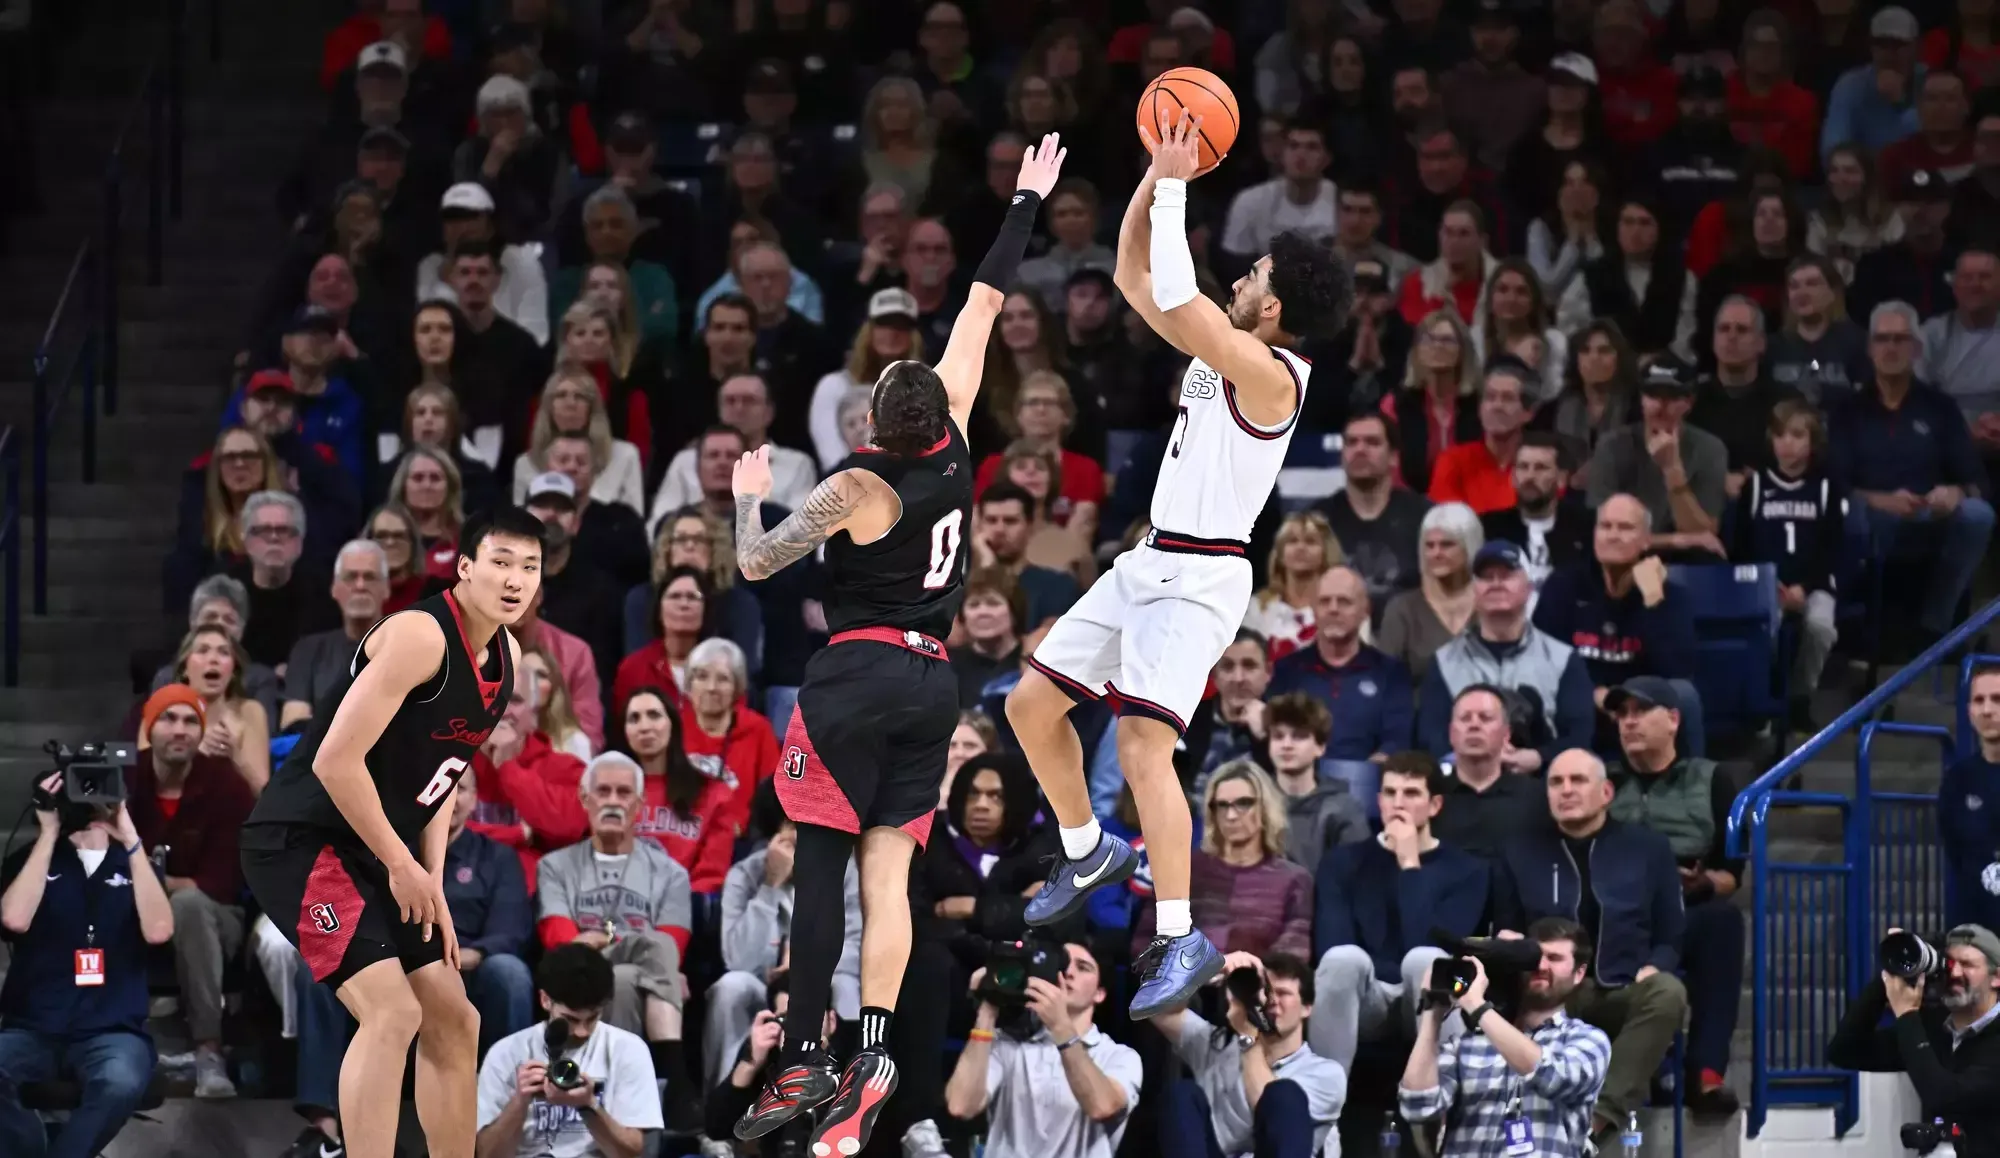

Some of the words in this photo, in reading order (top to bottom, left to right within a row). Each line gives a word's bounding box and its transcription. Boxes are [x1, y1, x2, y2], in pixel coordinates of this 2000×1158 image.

[923, 507, 964, 591] 0
[1784, 521, 1796, 554] 1
[415, 756, 468, 807] 6
[80, 953, 99, 969] TV
